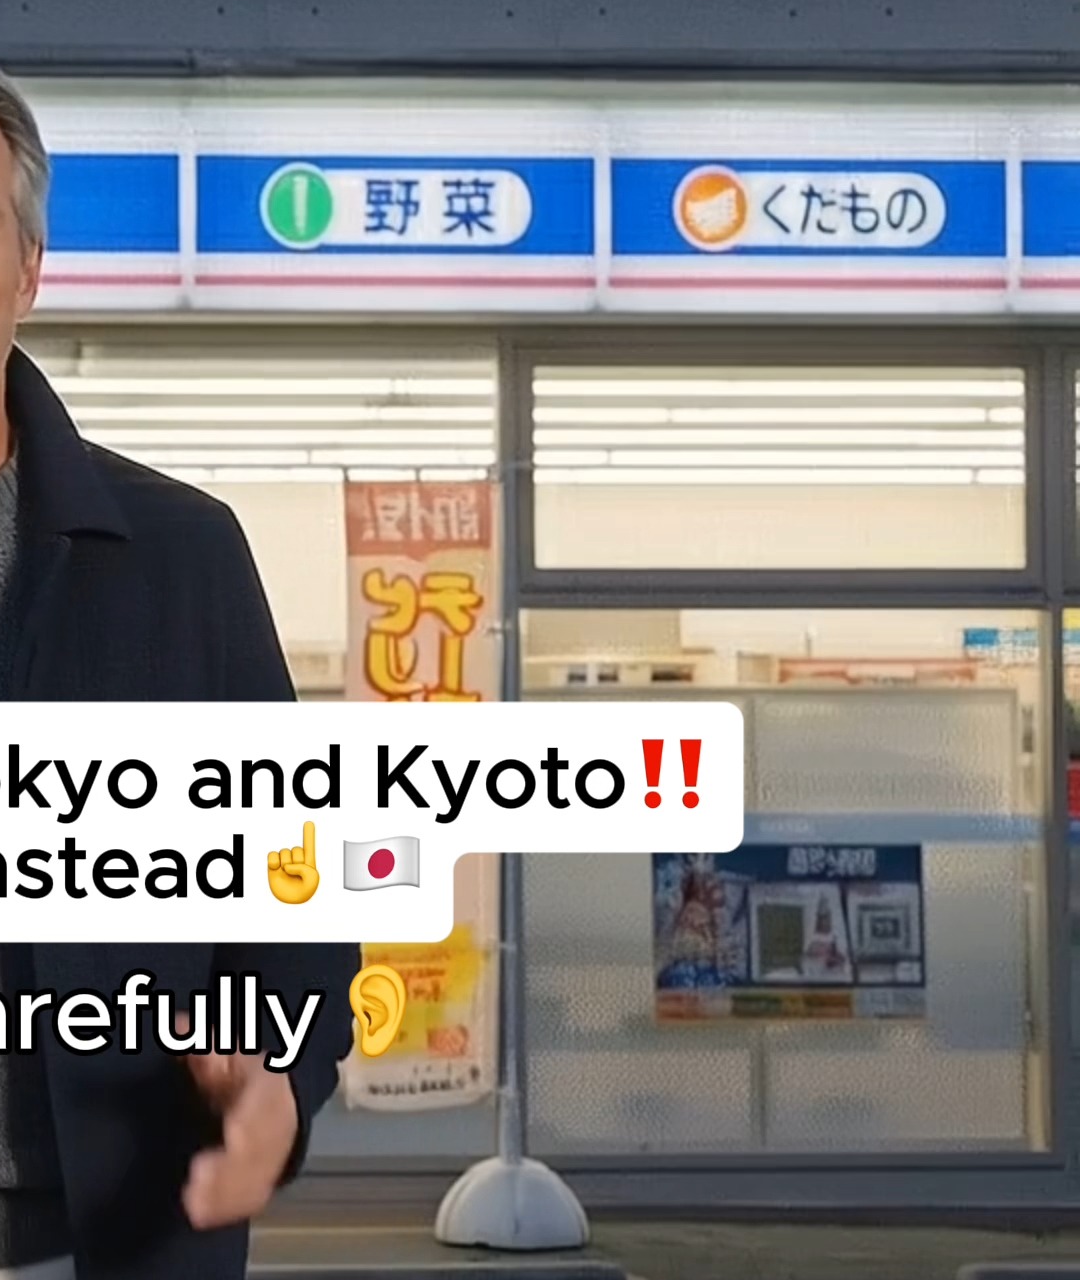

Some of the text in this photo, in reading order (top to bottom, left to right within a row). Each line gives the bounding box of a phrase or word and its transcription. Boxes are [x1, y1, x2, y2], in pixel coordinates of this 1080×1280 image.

[365, 178, 497, 239] 野菜
[762, 183, 929, 236] くだもの
